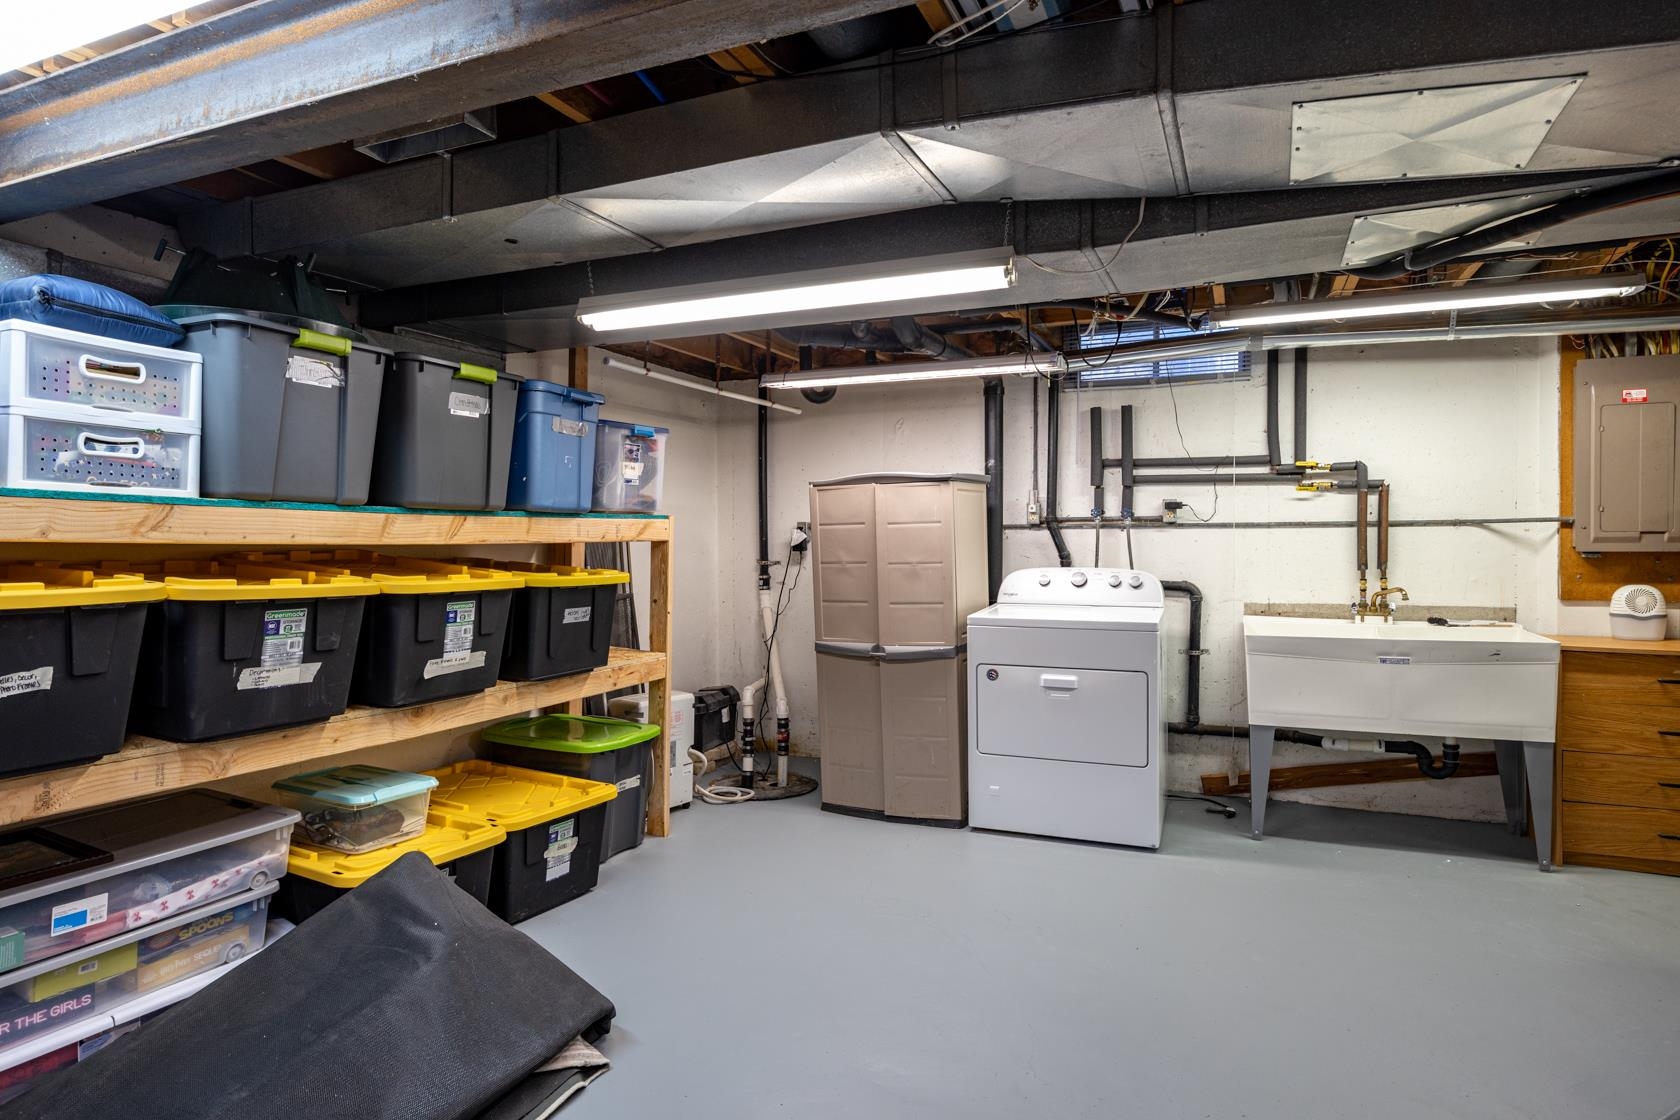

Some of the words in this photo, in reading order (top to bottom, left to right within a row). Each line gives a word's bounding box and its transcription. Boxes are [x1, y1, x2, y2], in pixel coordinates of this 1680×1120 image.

[179, 911, 234, 940] SPOONS
[14, 1009, 48, 1029] THE
[50, 994, 92, 1017] GIRLS
